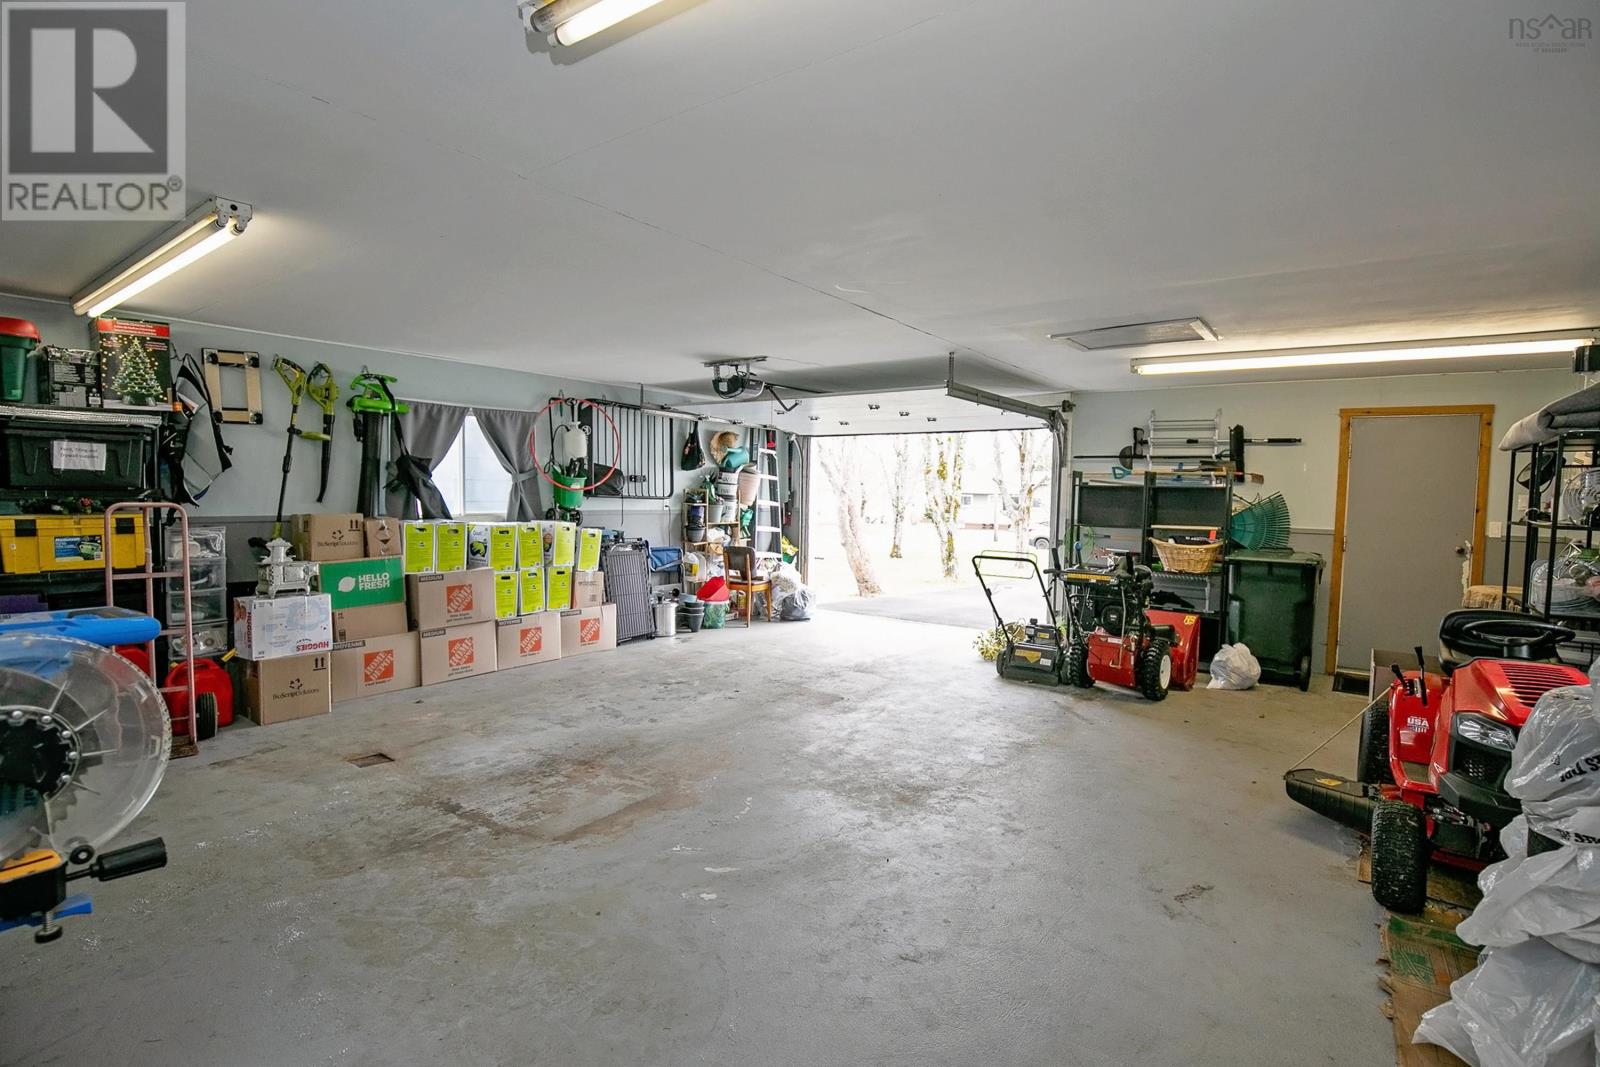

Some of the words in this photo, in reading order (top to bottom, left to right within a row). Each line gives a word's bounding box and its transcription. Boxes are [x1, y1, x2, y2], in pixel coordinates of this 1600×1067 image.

[358, 572, 390, 582] HELLO
[358, 580, 391, 590] FRESH
[296, 640, 329, 652] HUGGIES
[364, 651, 389, 675] HOME
[370, 653, 394, 680] DEPOT
[1407, 717, 1429, 727] USA
